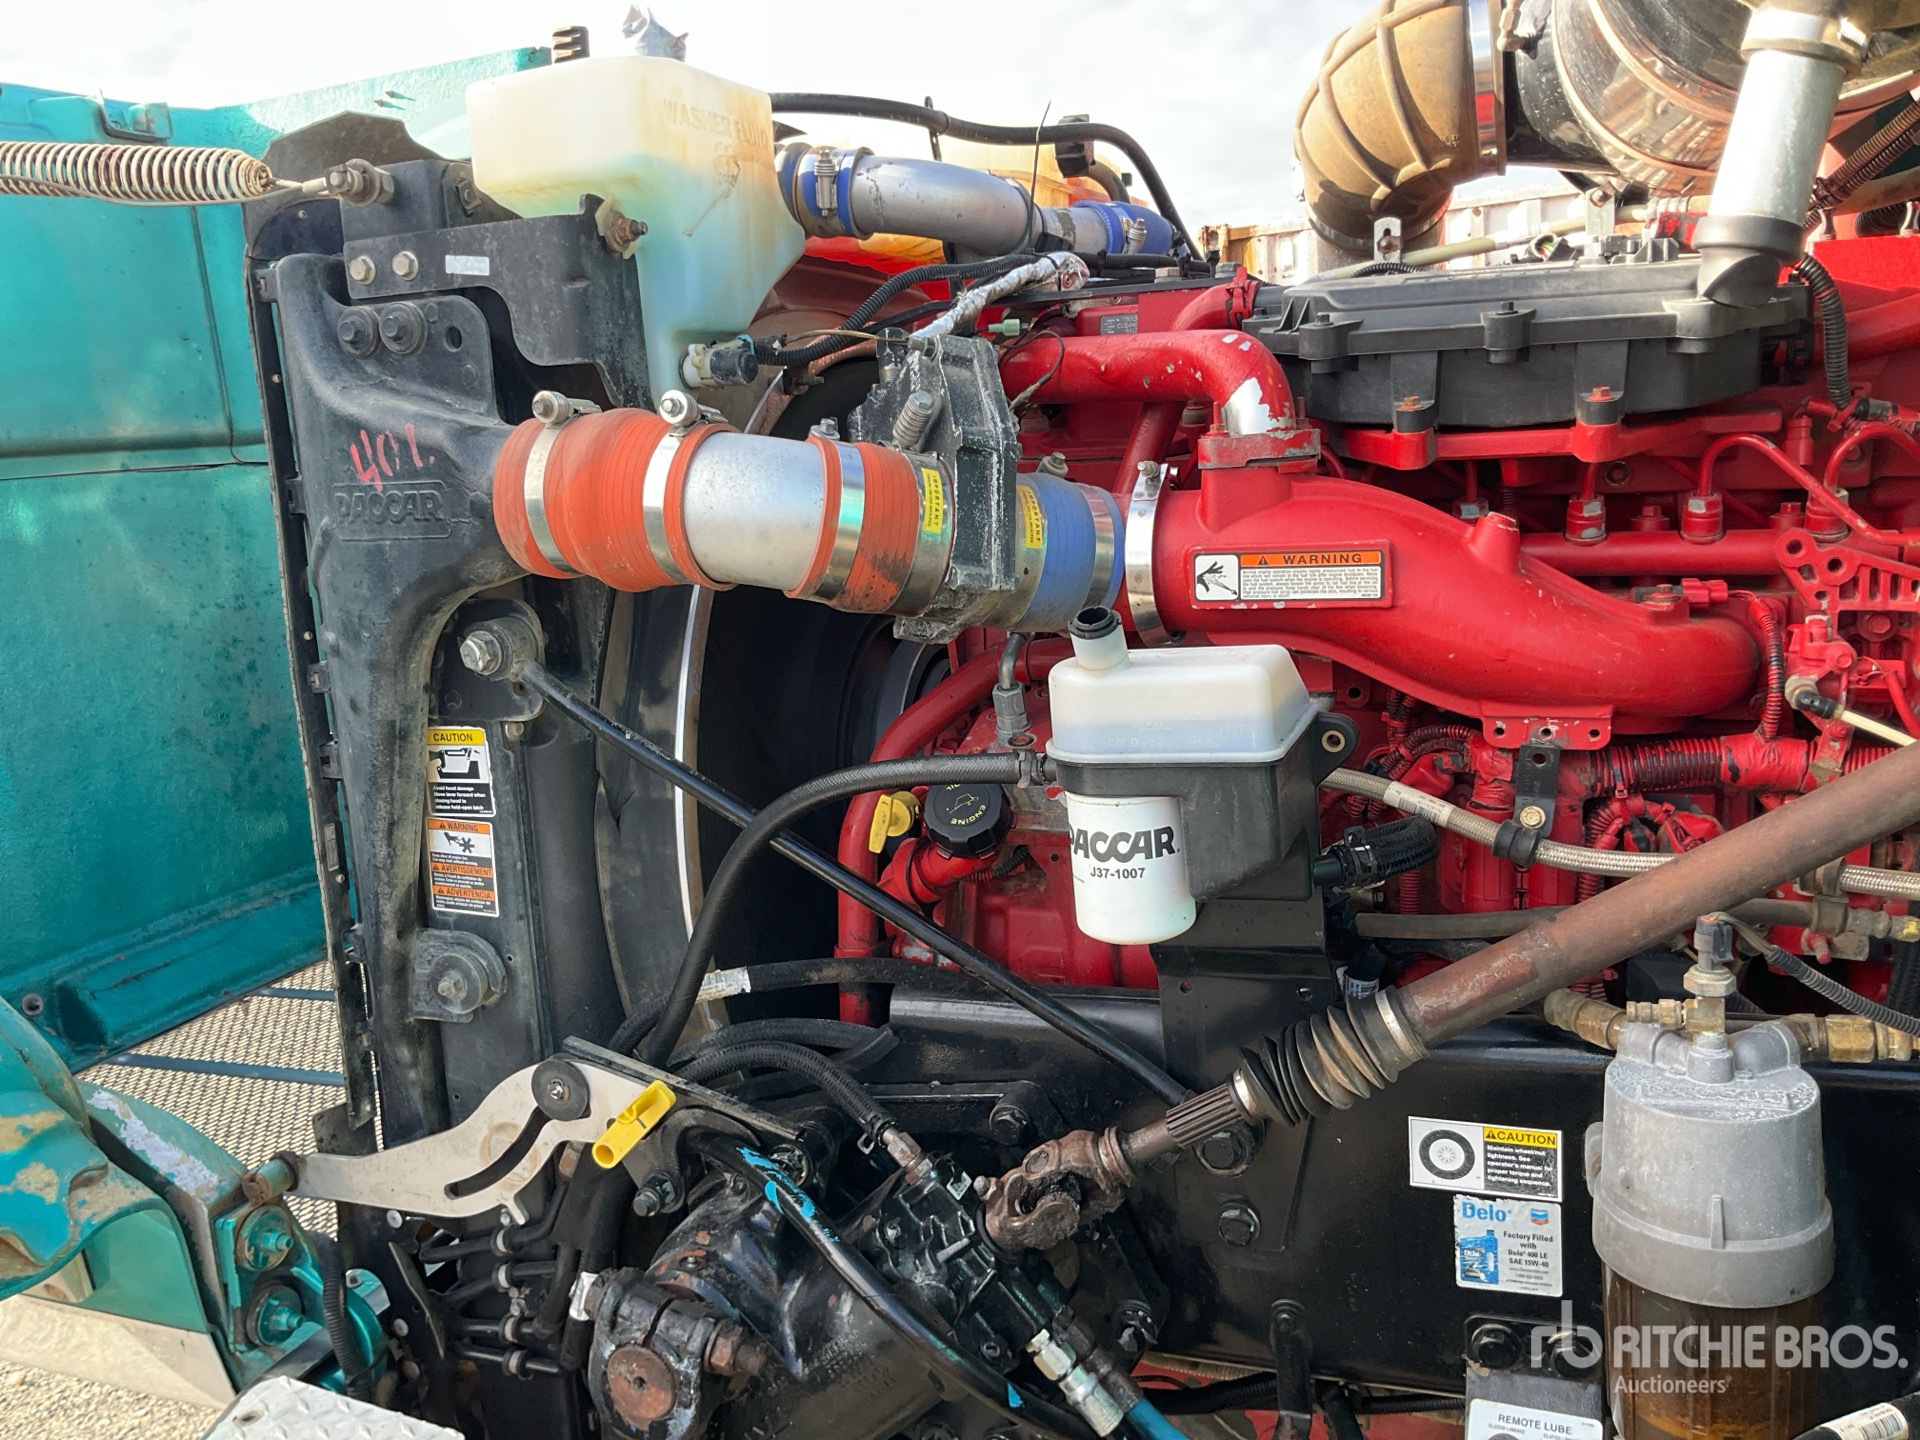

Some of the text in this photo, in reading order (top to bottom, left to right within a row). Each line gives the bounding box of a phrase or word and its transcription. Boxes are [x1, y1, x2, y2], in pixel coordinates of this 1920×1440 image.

[663, 97, 732, 137] WASHER
[333, 490, 444, 524] PACCAR
[932, 475, 940, 527] IMPORTANT
[1028, 491, 1041, 542] IMPORTANT
[1283, 554, 1362, 564] WARNING
[433, 733, 473, 741] CAUTION
[1107, 738, 1139, 748] COLD
[951, 804, 986, 825] ENGINE
[448, 822, 478, 832] WARNING
[442, 864, 491, 877] AVERTISSEMENT
[1090, 867, 1146, 879] J37-1007
[447, 887, 491, 899] ADVERTENCIA
[1497, 1131, 1555, 1145] CAUTION
[1487, 1175, 1518, 1184] tightening
[1503, 1231, 1553, 1242] Factory Filled
[1525, 1259, 1549, 1268] 15W-40
[1498, 1414, 1572, 1434] REMOTE LUBE
